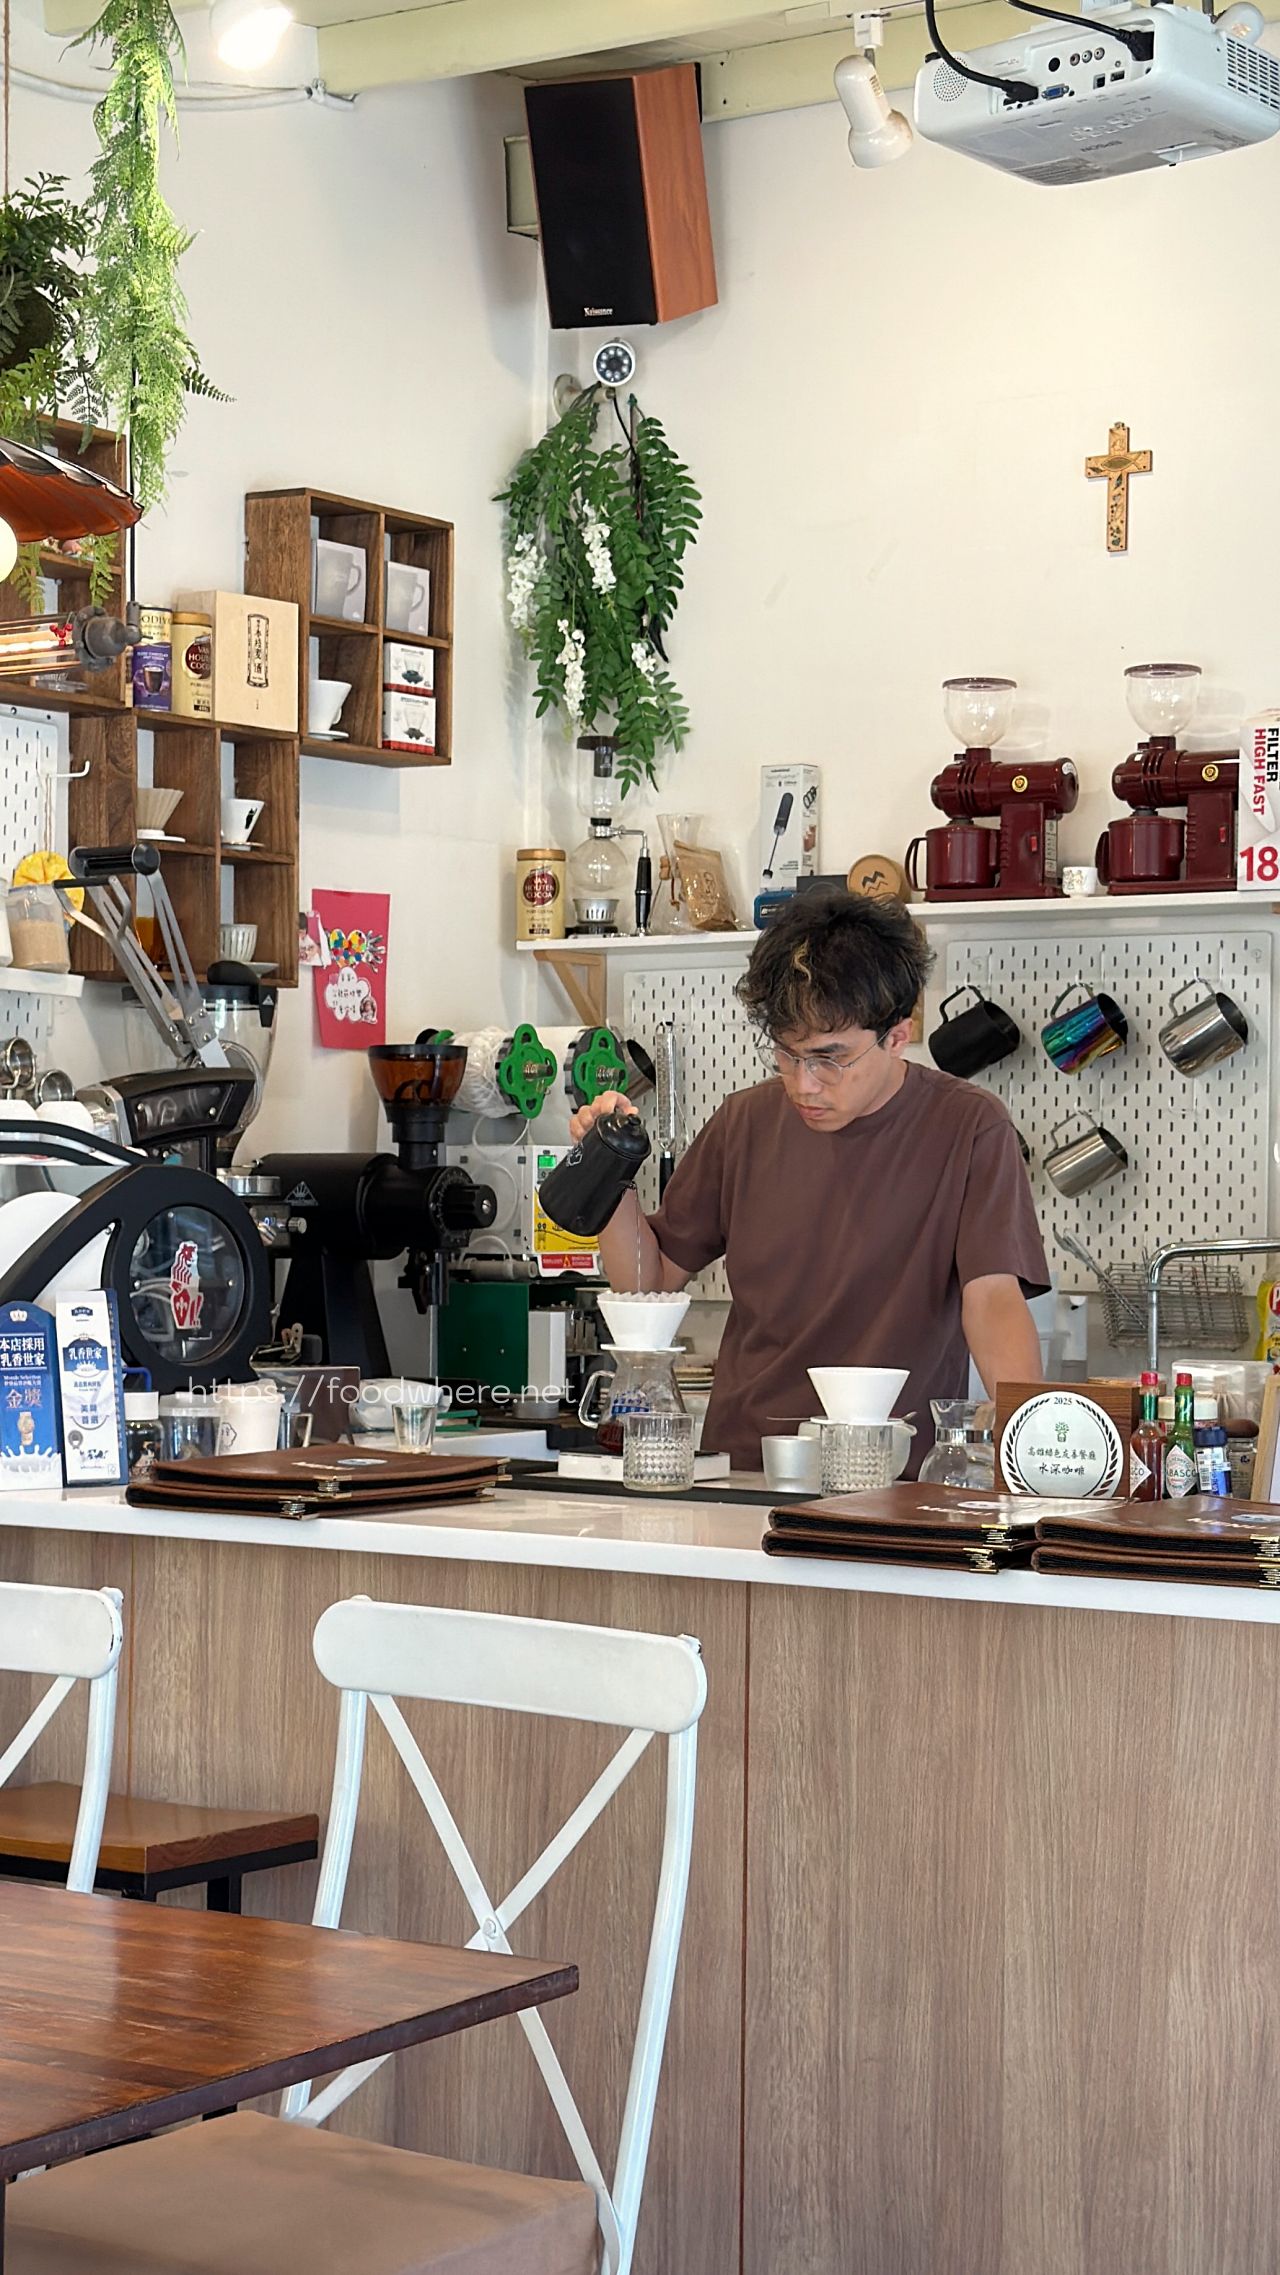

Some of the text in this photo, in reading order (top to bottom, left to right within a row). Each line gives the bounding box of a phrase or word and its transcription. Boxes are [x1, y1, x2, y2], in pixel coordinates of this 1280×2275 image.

[1267, 728, 1279, 782] FILTER
[1253, 729, 1266, 815] HIGH FAST
[1240, 846, 1279, 882] 18
[0, 1337, 45, 1351] 本店採用
[1, 1354, 46, 1367] 乳香世家
[69, 1348, 102, 1360] 乳香世家
[6, 1388, 43, 1409] 金獎
[1053, 1396, 1073, 1406] 2025
[1167, 1468, 1196, 1478] BASCO
